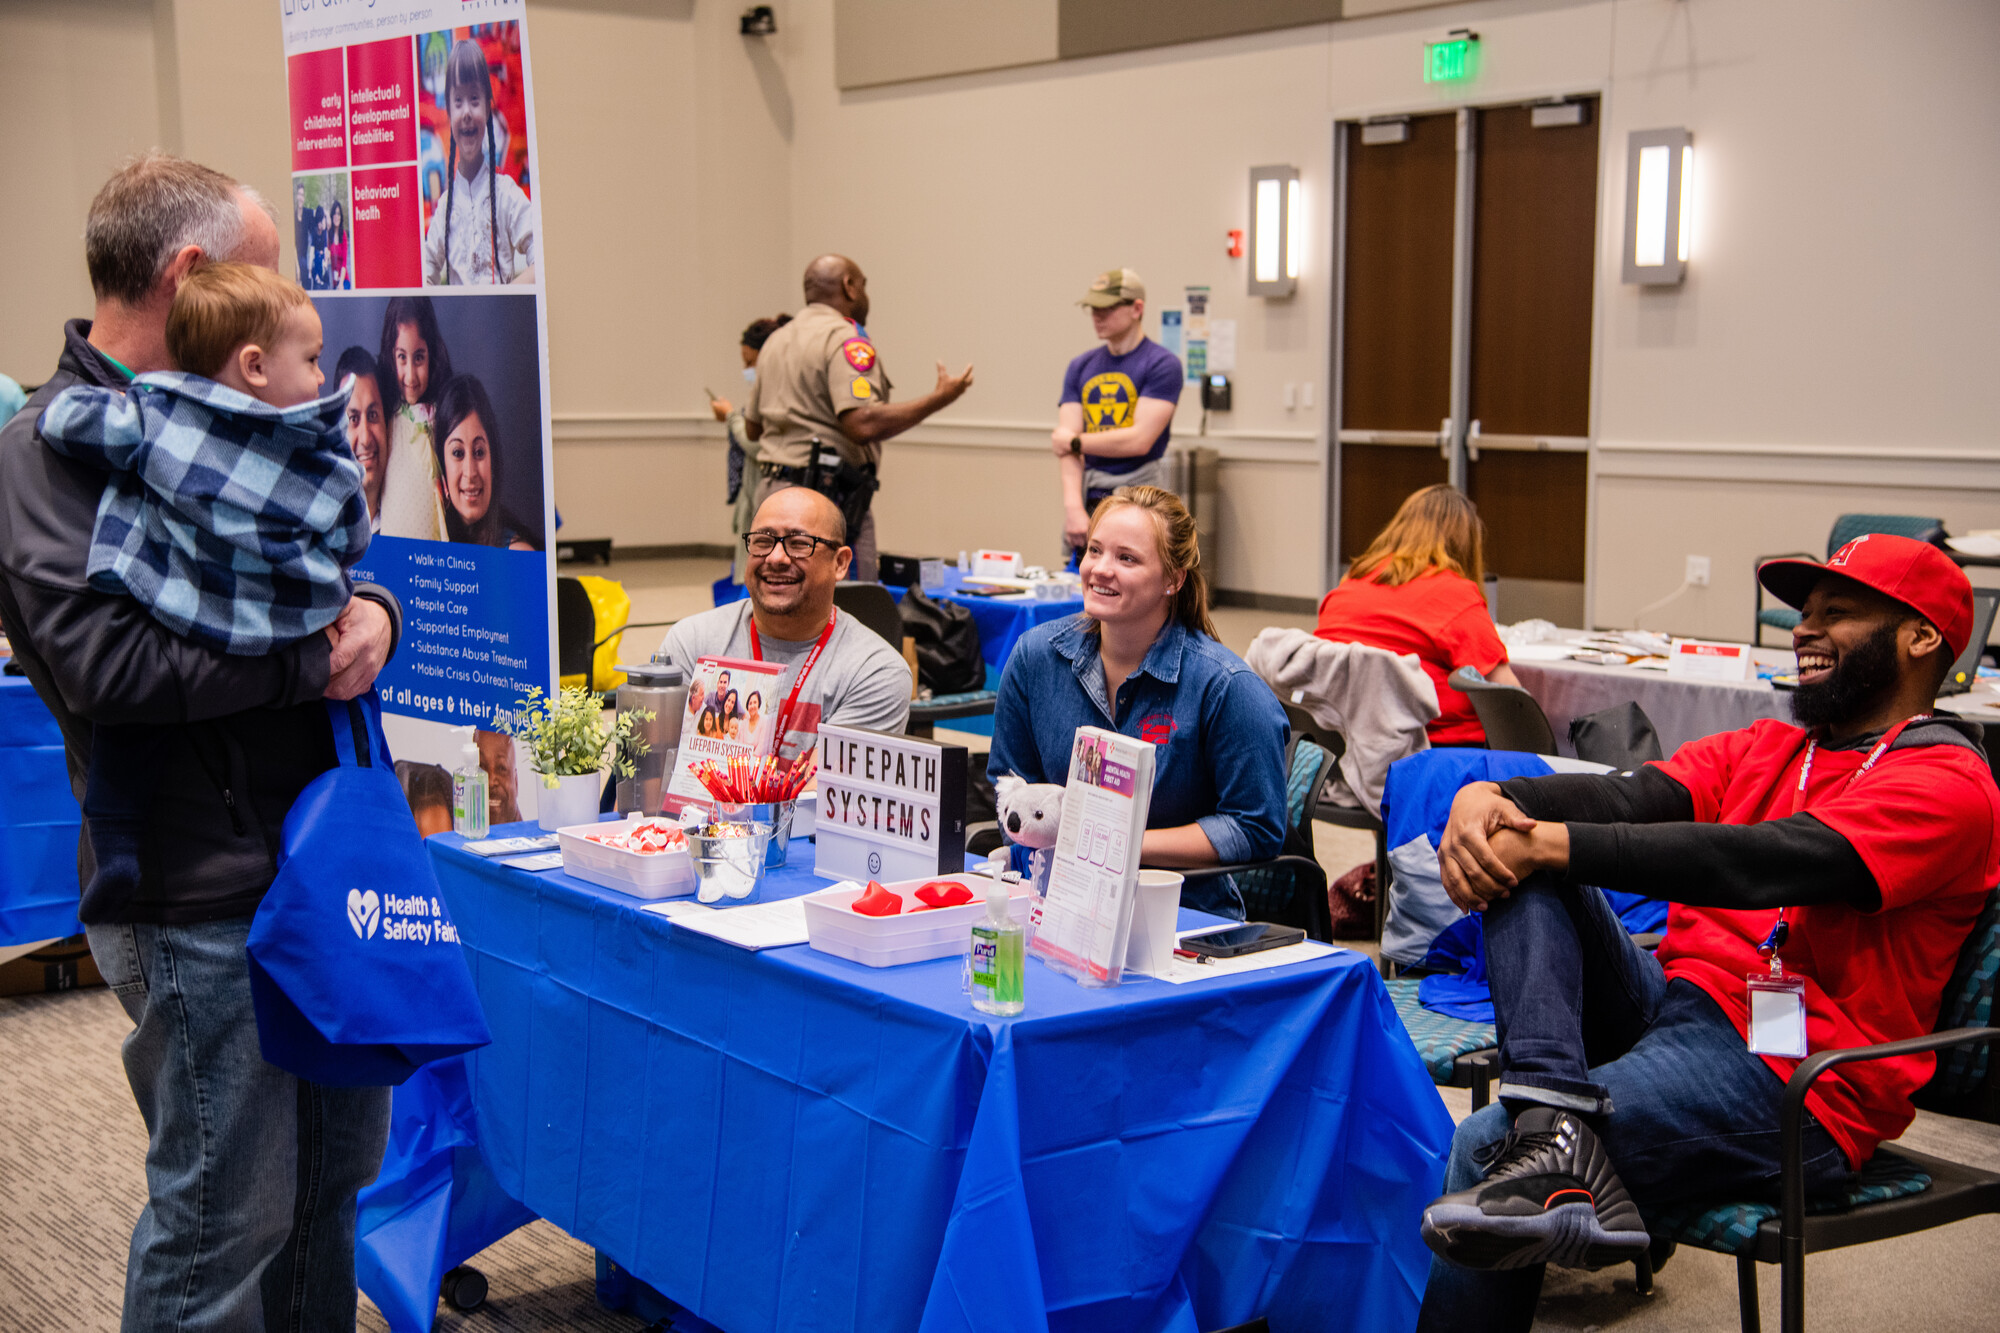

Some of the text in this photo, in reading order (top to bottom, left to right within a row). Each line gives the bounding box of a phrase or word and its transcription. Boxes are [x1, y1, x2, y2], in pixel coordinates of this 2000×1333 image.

[409, 8, 432, 24] person
[321, 94, 342, 109] early
[351, 84, 401, 105] intellectual &
[304, 113, 342, 131] childhood
[351, 104, 410, 126] developmental
[297, 134, 343, 151] intervention
[352, 129, 395, 146] disabilities
[354, 183, 400, 201] behavioral
[355, 204, 381, 221] health
[414, 553, 476, 571] Walk-in Clinics
[415, 575, 479, 595] Family Support
[415, 597, 468, 615] Respite Care
[416, 618, 510, 644] Supported Employment
[417, 640, 528, 670] Substance Abuse Treatment
[805, 645, 821, 667] Systems
[417, 662, 444, 678] Mobile
[446, 667, 471, 682] Crisis
[472, 670, 509, 689] Outreach
[382, 686, 394, 701] of
[397, 688, 411, 705] all
[414, 695, 444, 712] ages
[447, 696, 455, 713] &
[459, 698, 491, 718] their
[689, 736, 720, 755] LIFEPATH
[721, 743, 753, 761] SYSTEMS
[1861, 742, 1887, 771] Systems
[823, 737, 936, 793] LIFEPATH
[1103, 773, 1114, 784] FIRST
[826, 787, 931, 841] SYSTEMS
[384, 893, 441, 917] Health &
[383, 917, 432, 946] Safety
